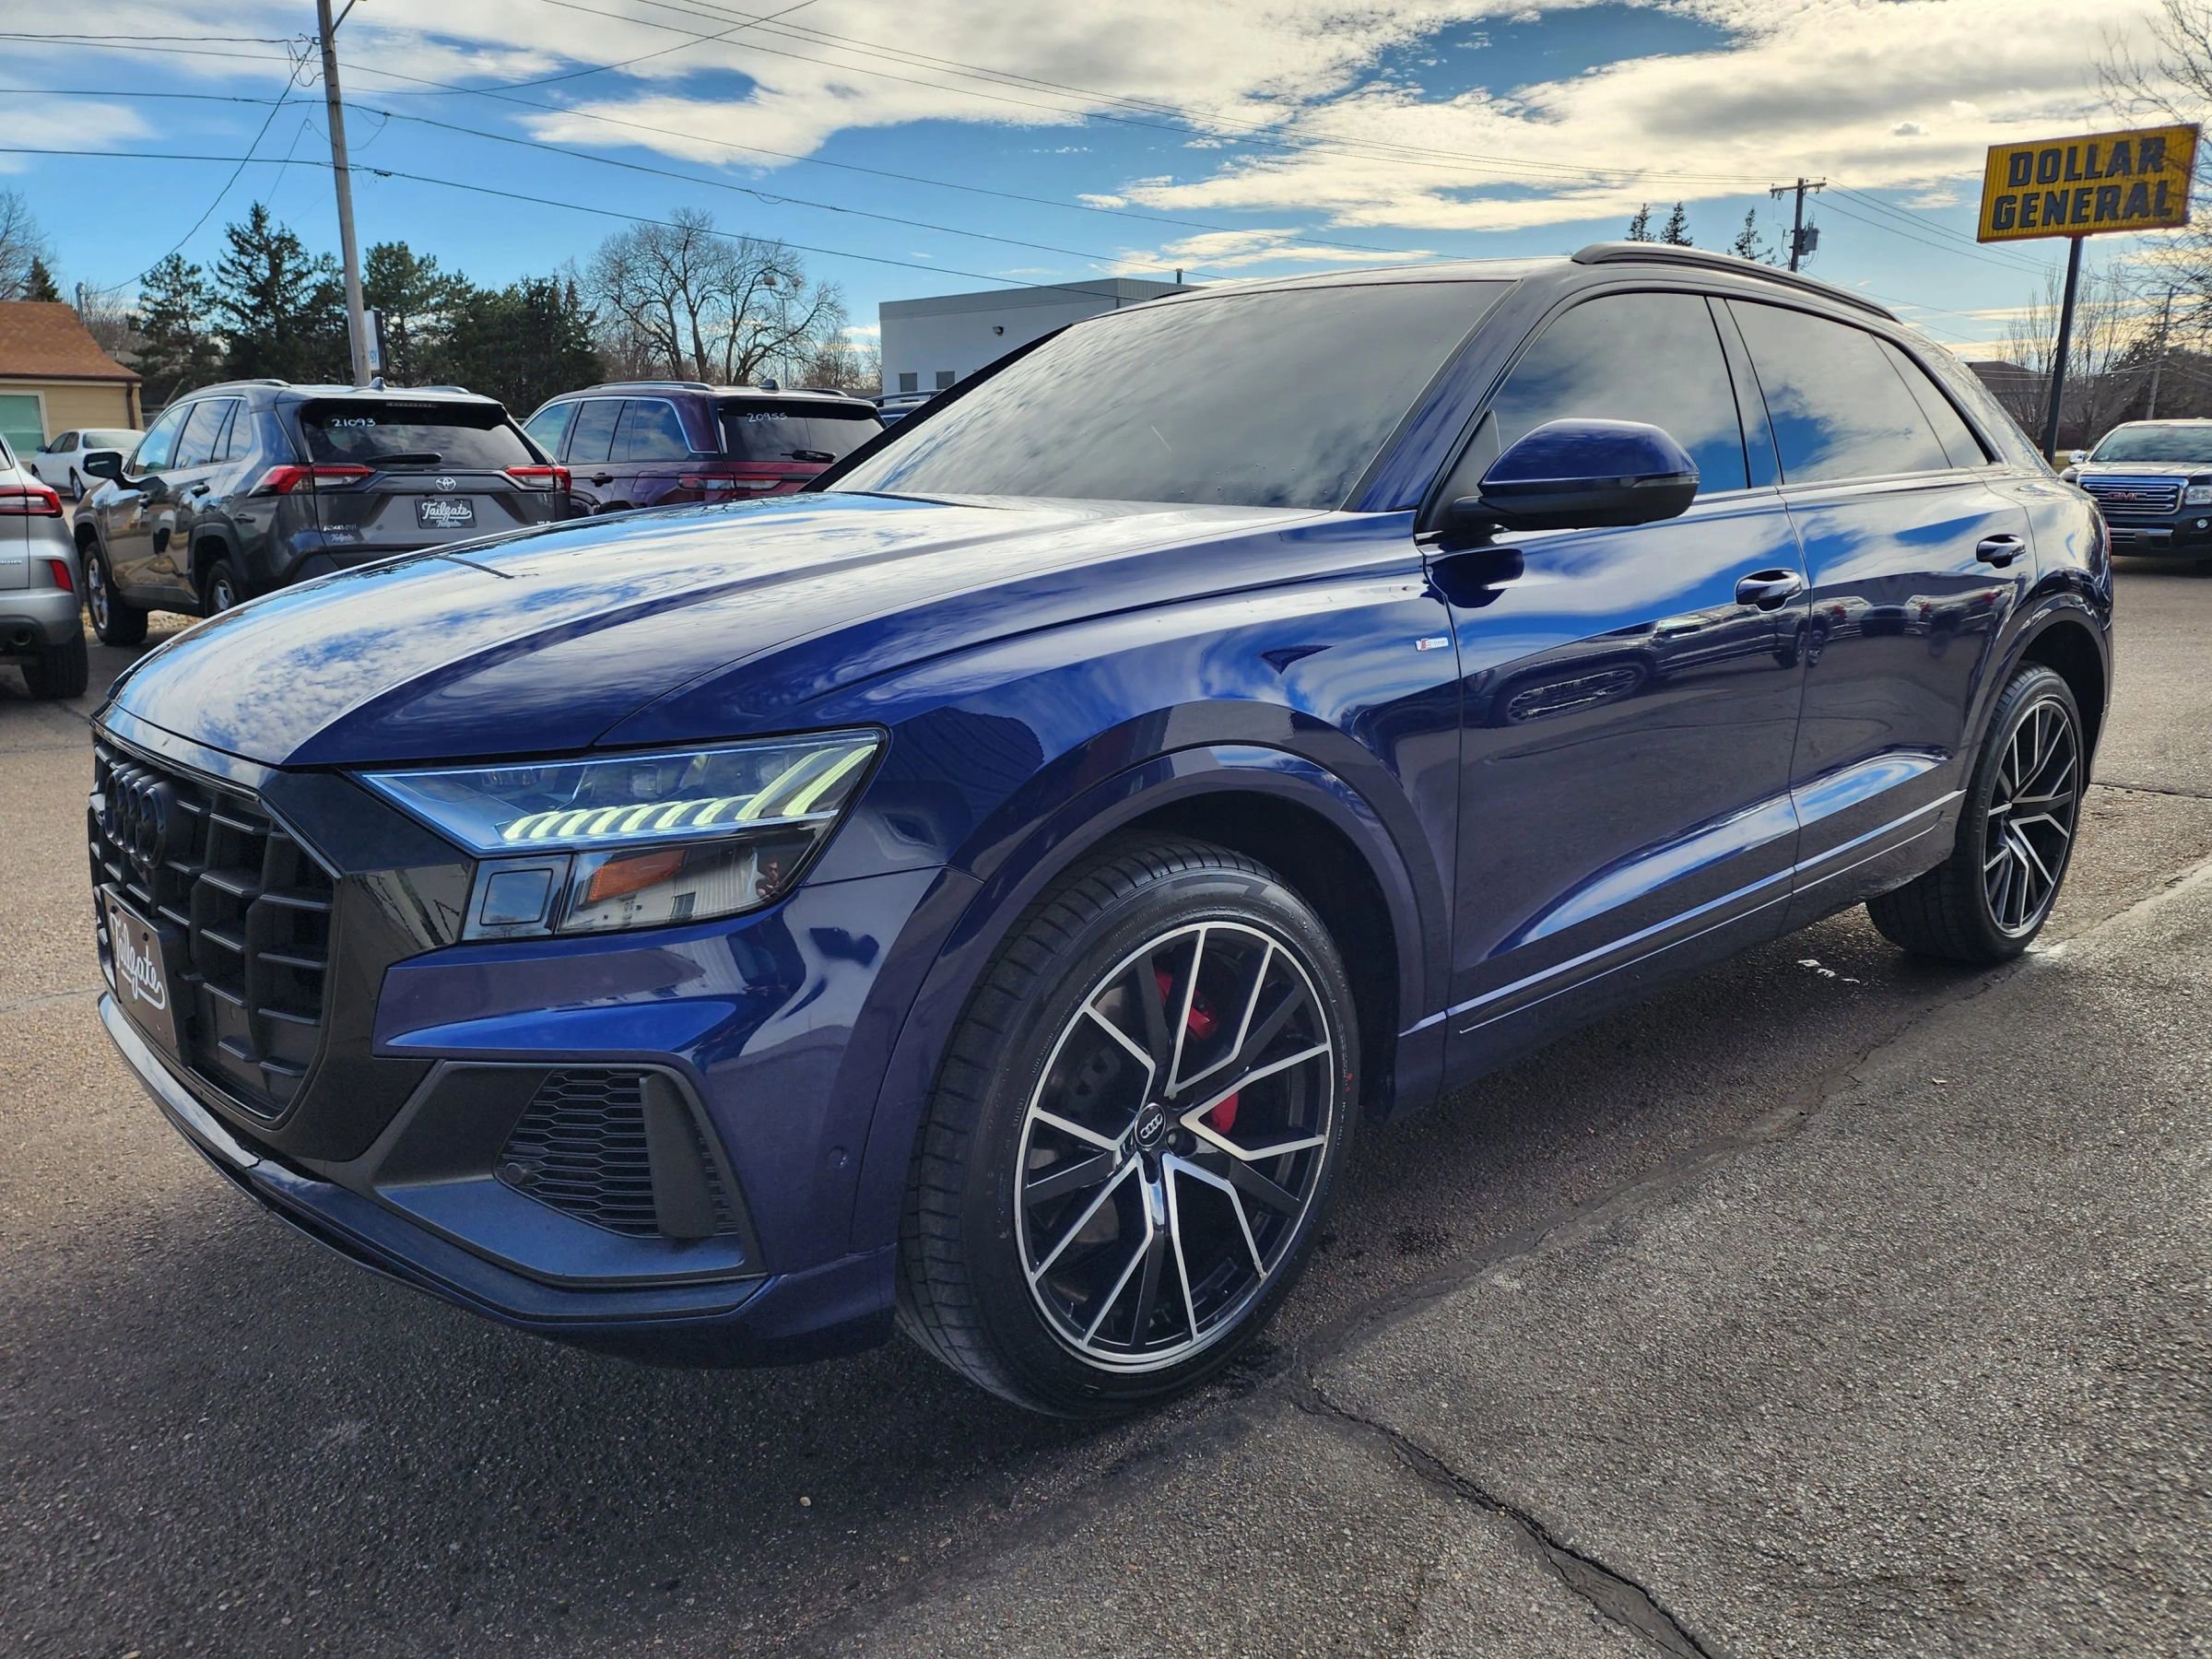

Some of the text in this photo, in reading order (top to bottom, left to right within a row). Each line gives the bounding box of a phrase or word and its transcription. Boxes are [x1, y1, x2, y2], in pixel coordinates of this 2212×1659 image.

[2007, 136, 2167, 187] DOLLAR
[1992, 180, 2173, 230] GENERAL
[331, 418, 376, 427] 21093
[747, 412, 788, 422] 20955
[2108, 491, 2147, 500] GMC
[421, 500, 473, 521] Tailgate
[110, 912, 166, 1010] Tailgate
